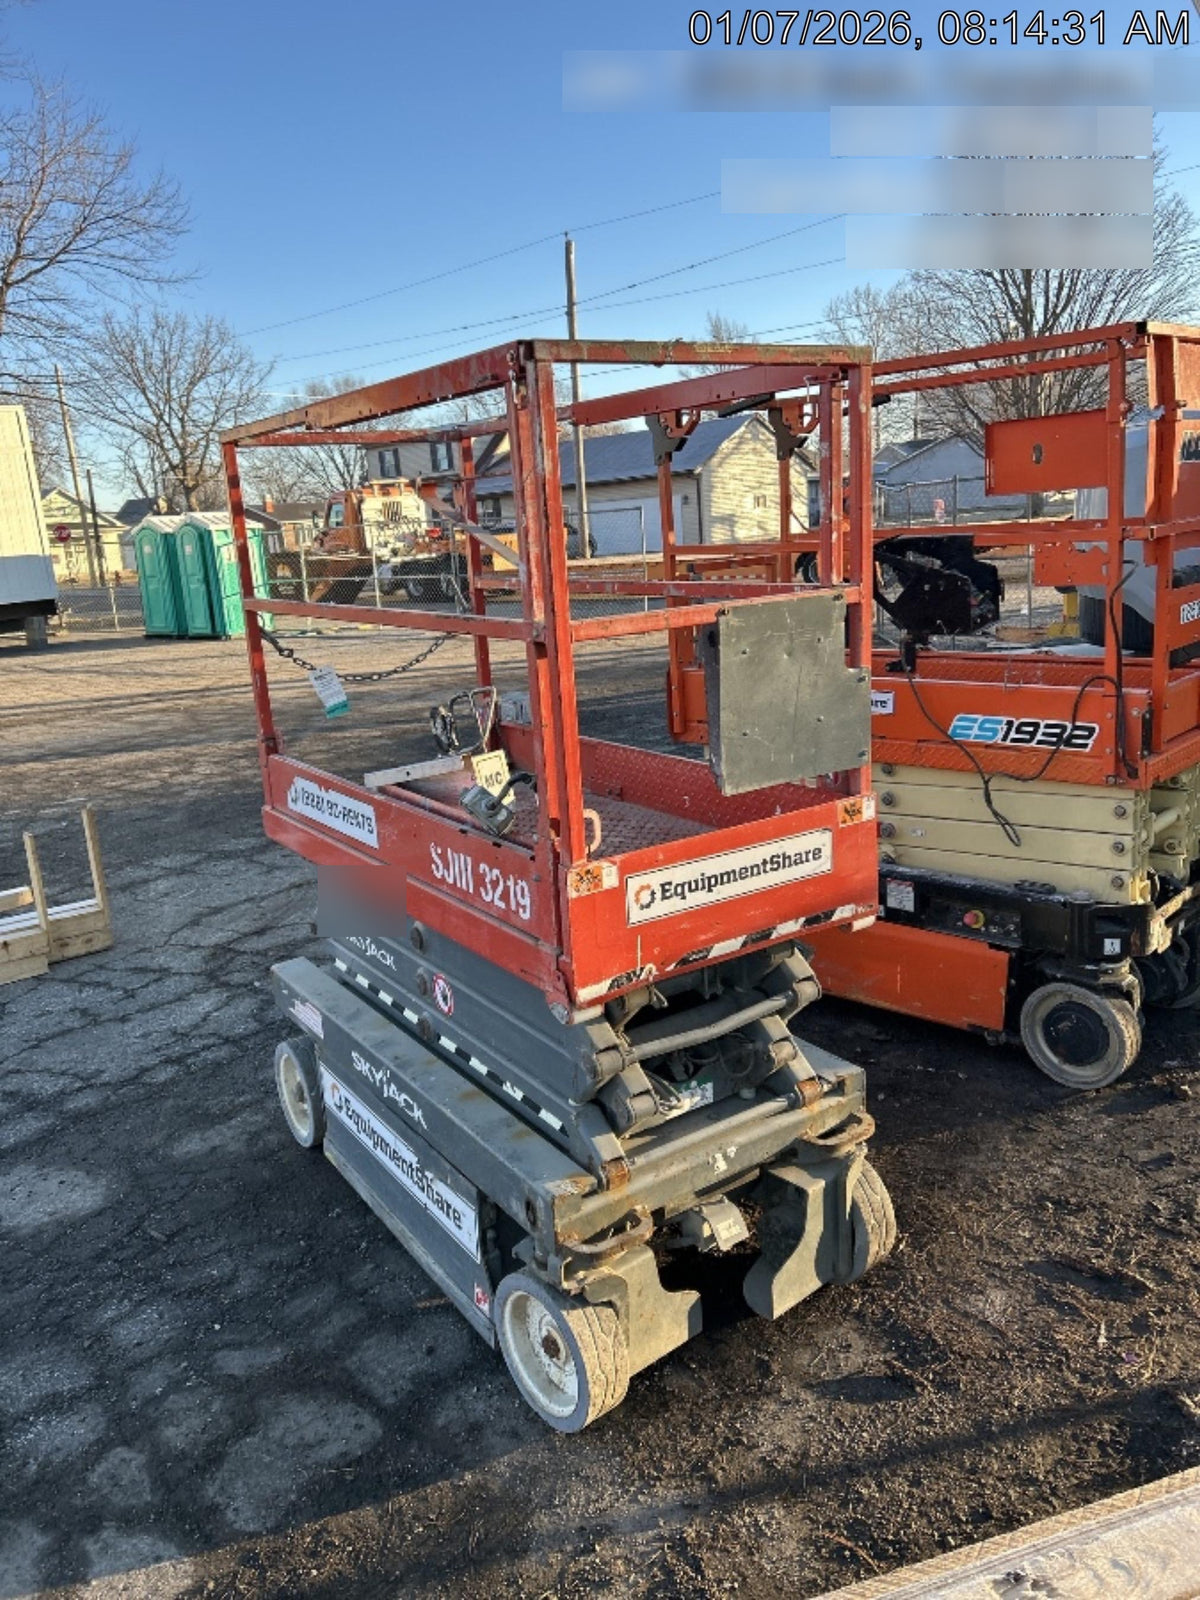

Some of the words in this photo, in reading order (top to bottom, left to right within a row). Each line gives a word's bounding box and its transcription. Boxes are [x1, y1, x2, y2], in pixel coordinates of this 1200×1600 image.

[950, 715, 1096, 750] ES1932
[479, 862, 532, 920] 3219
[659, 846, 824, 902] EquipmentShare
[350, 1049, 429, 1131] SKYJACK
[344, 1096, 464, 1230] EquipmentShare
